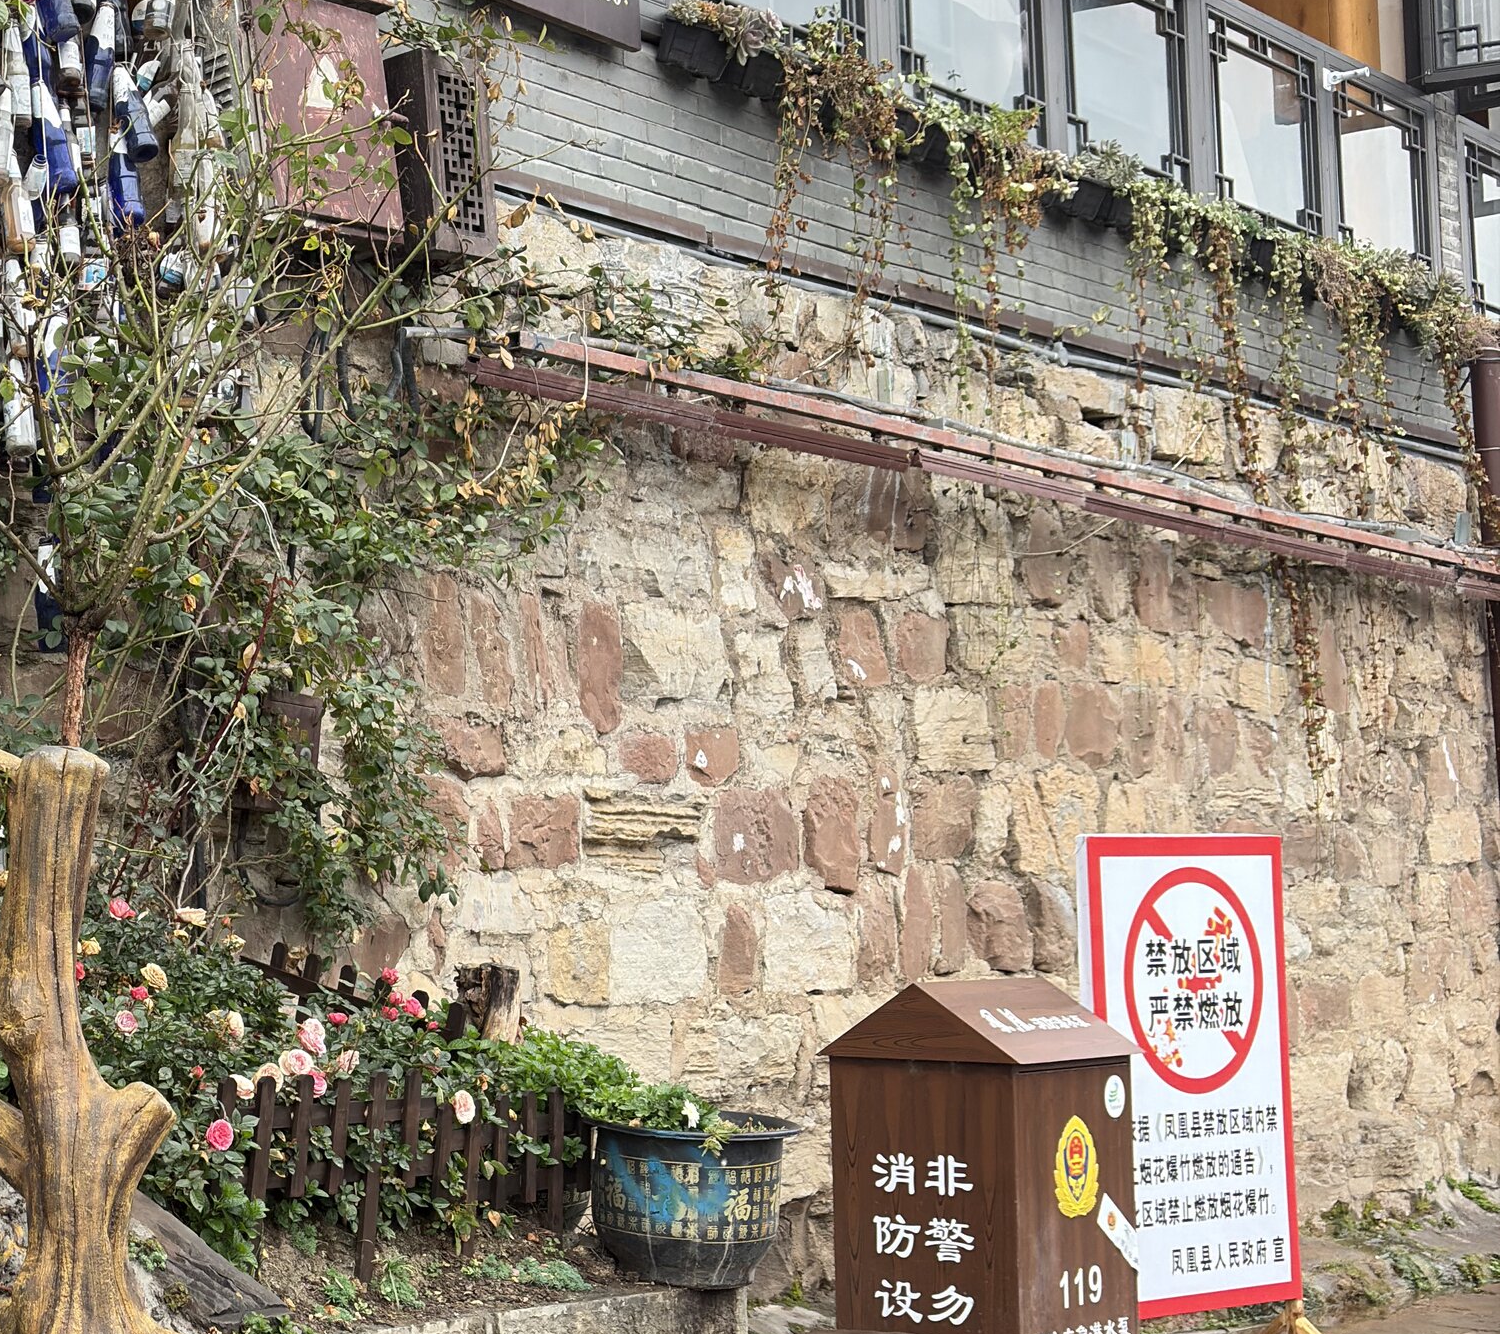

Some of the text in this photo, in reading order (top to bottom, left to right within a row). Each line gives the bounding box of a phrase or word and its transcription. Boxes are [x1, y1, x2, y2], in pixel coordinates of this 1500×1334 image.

[1146, 937, 1241, 977] 禁放区域
[1149, 991, 1243, 1032] 严禁燃放
[1132, 1104, 1277, 1143] 据《凤凰县禁放区域内禁
[723, 1188, 752, 1222] 福
[1135, 1188, 1277, 1229] 区域禁止燃放烟花爆竹。
[1172, 1237, 1267, 1276] 凤凰县人民政府
[1273, 1236, 1285, 1263] 宣
[1059, 1265, 1102, 1310] 119
